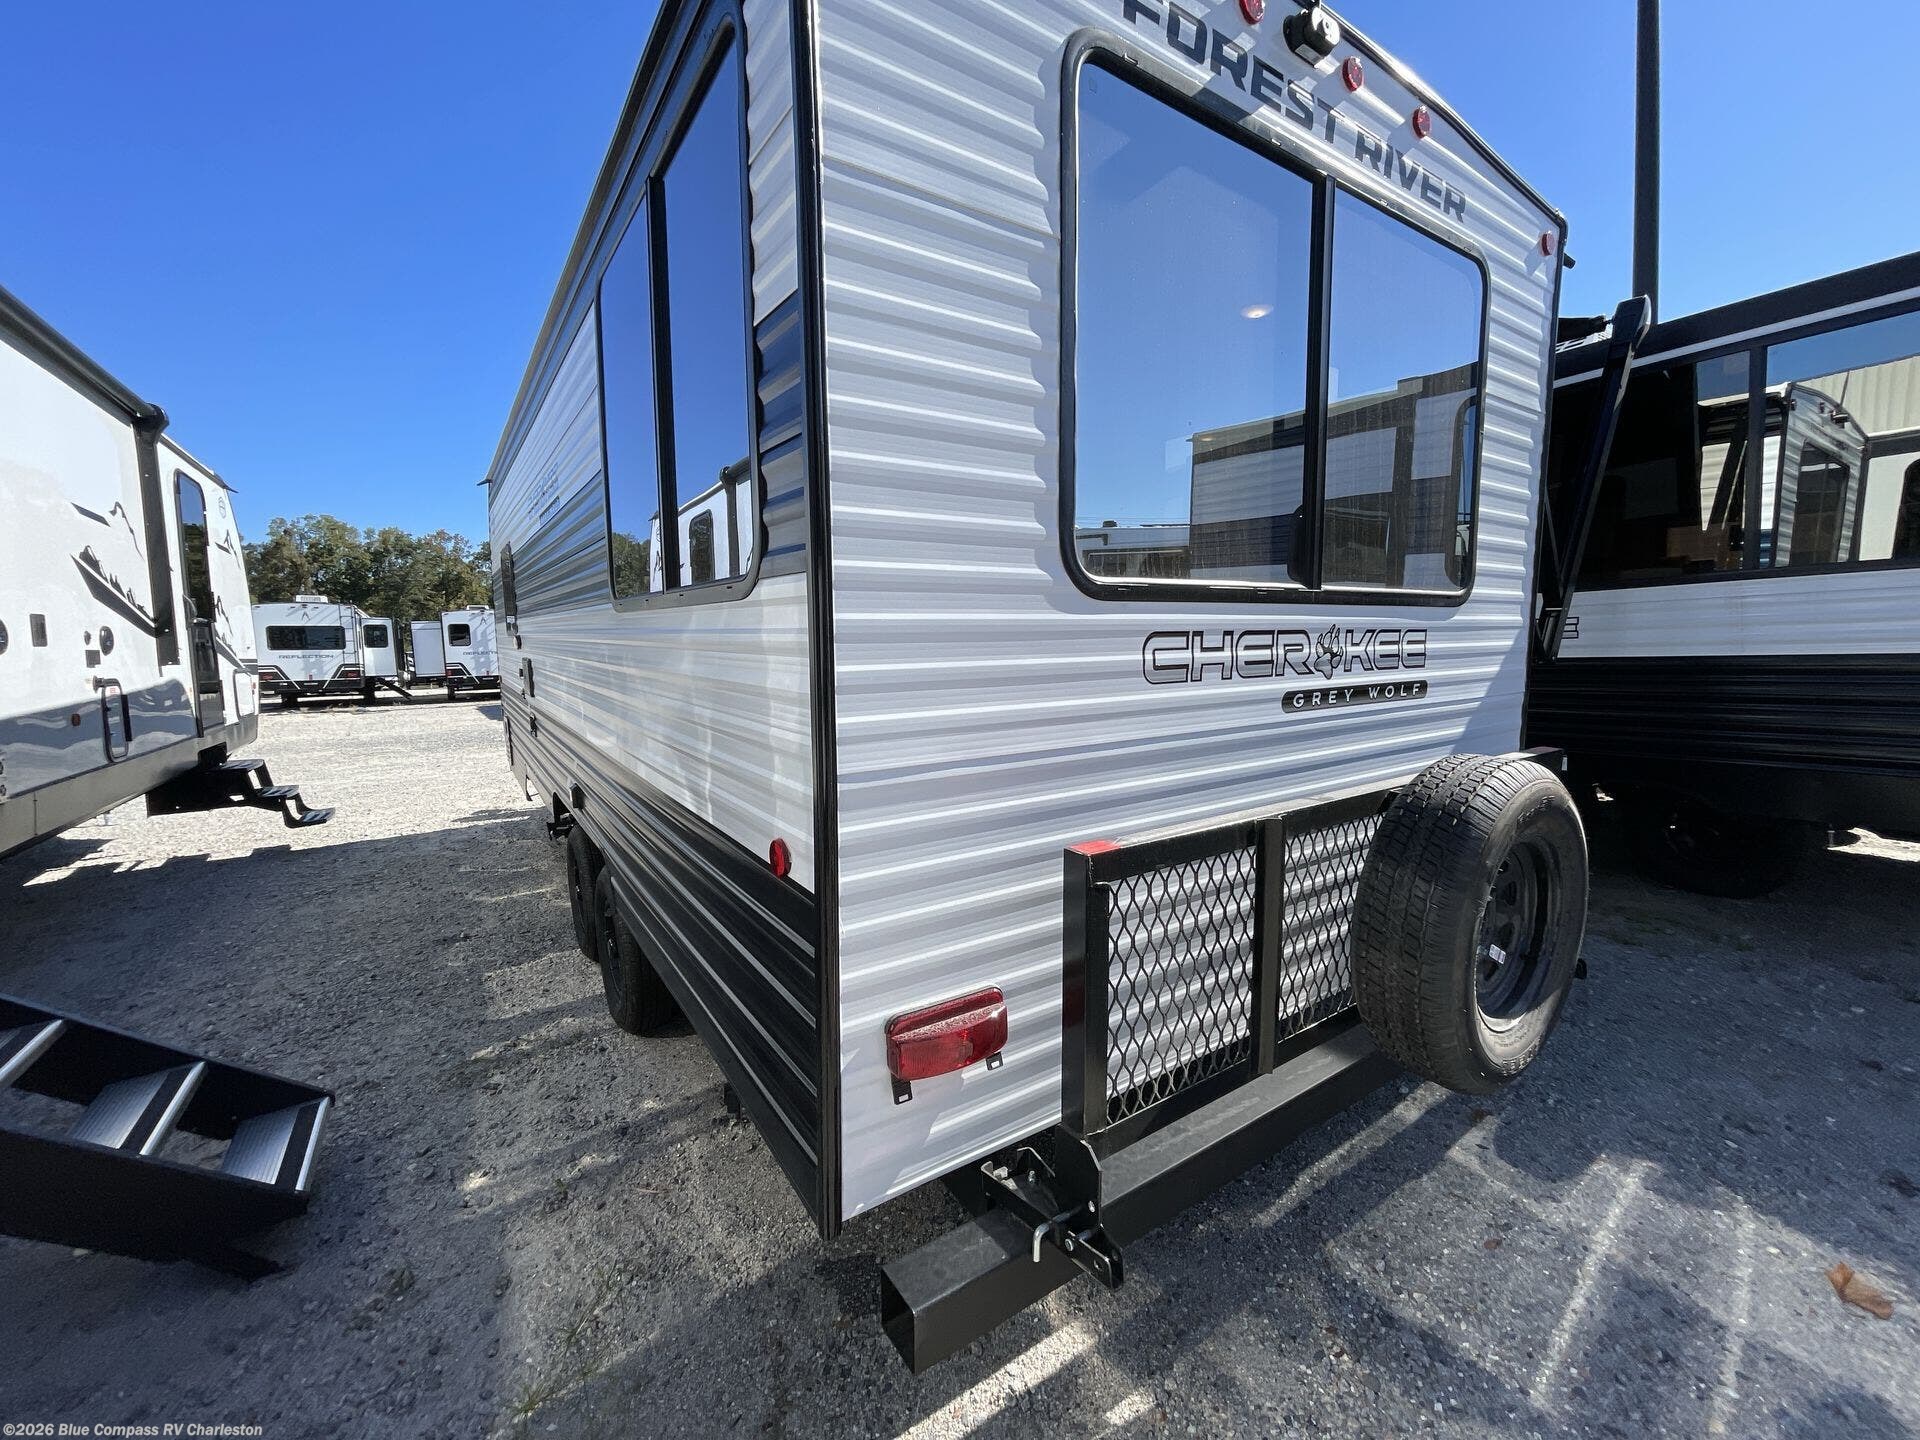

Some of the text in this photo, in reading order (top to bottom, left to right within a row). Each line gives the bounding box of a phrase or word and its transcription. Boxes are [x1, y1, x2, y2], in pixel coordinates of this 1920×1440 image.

[1355, 122, 1468, 224] RIVER
[1293, 682, 1421, 709] GREY WOLF
